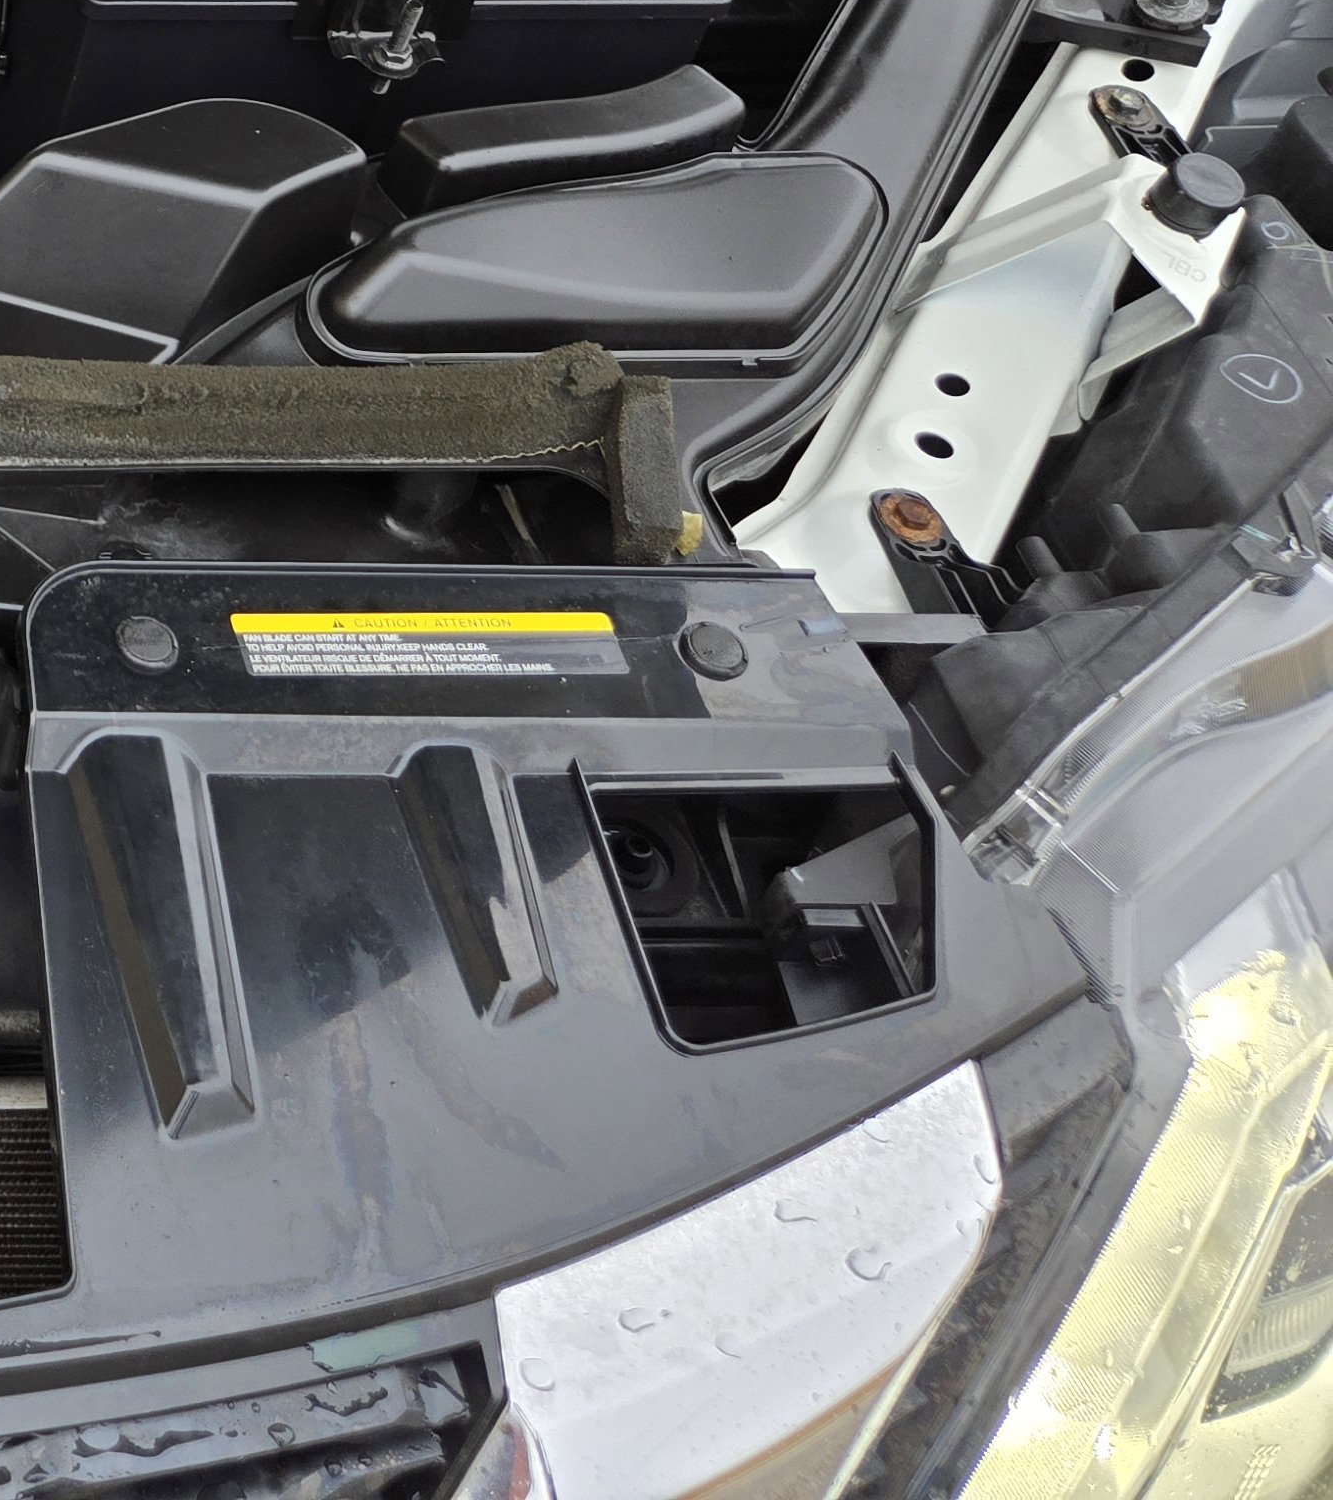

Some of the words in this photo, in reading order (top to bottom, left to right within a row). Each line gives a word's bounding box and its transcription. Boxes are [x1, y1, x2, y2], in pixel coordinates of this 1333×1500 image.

[354, 618, 418, 628] CAUTION
[434, 617, 512, 628] ATTENTION
[243, 634, 262, 642] FAN
[263, 634, 293, 642] BLADE
[294, 634, 315, 642] CAN
[316, 634, 344, 642] START
[346, 634, 357, 642] AT
[359, 634, 376, 642] ANY
[246, 643, 260, 652] TO
[261, 643, 284, 652] HELP
[286, 643, 314, 652] AVOID
[315, 643, 365, 652] PERSONAL
[422, 643, 455, 652] HANDS
[456, 643, 489, 651] CLEAR.
[249, 654, 261, 663] LE
[262, 654, 322, 663] VENTILATEUR
[323, 654, 357, 663] RISQUE
[359, 654, 372, 663] DE
[373, 652, 424, 663] DÉMARRER
[434, 654, 457, 662] TOUT
[458, 654, 502, 662] MOMENT.
[252, 664, 280, 673] POUR
[282, 662, 312, 673] ÉVITER
[313, 664, 344, 673] TOUTE
[396, 664, 410, 673] NE
[411, 664, 429, 673] PAS
[430, 664, 444, 673] EN
[445, 664, 504, 673] APPROCHER
[504, 664, 522, 672] LES
